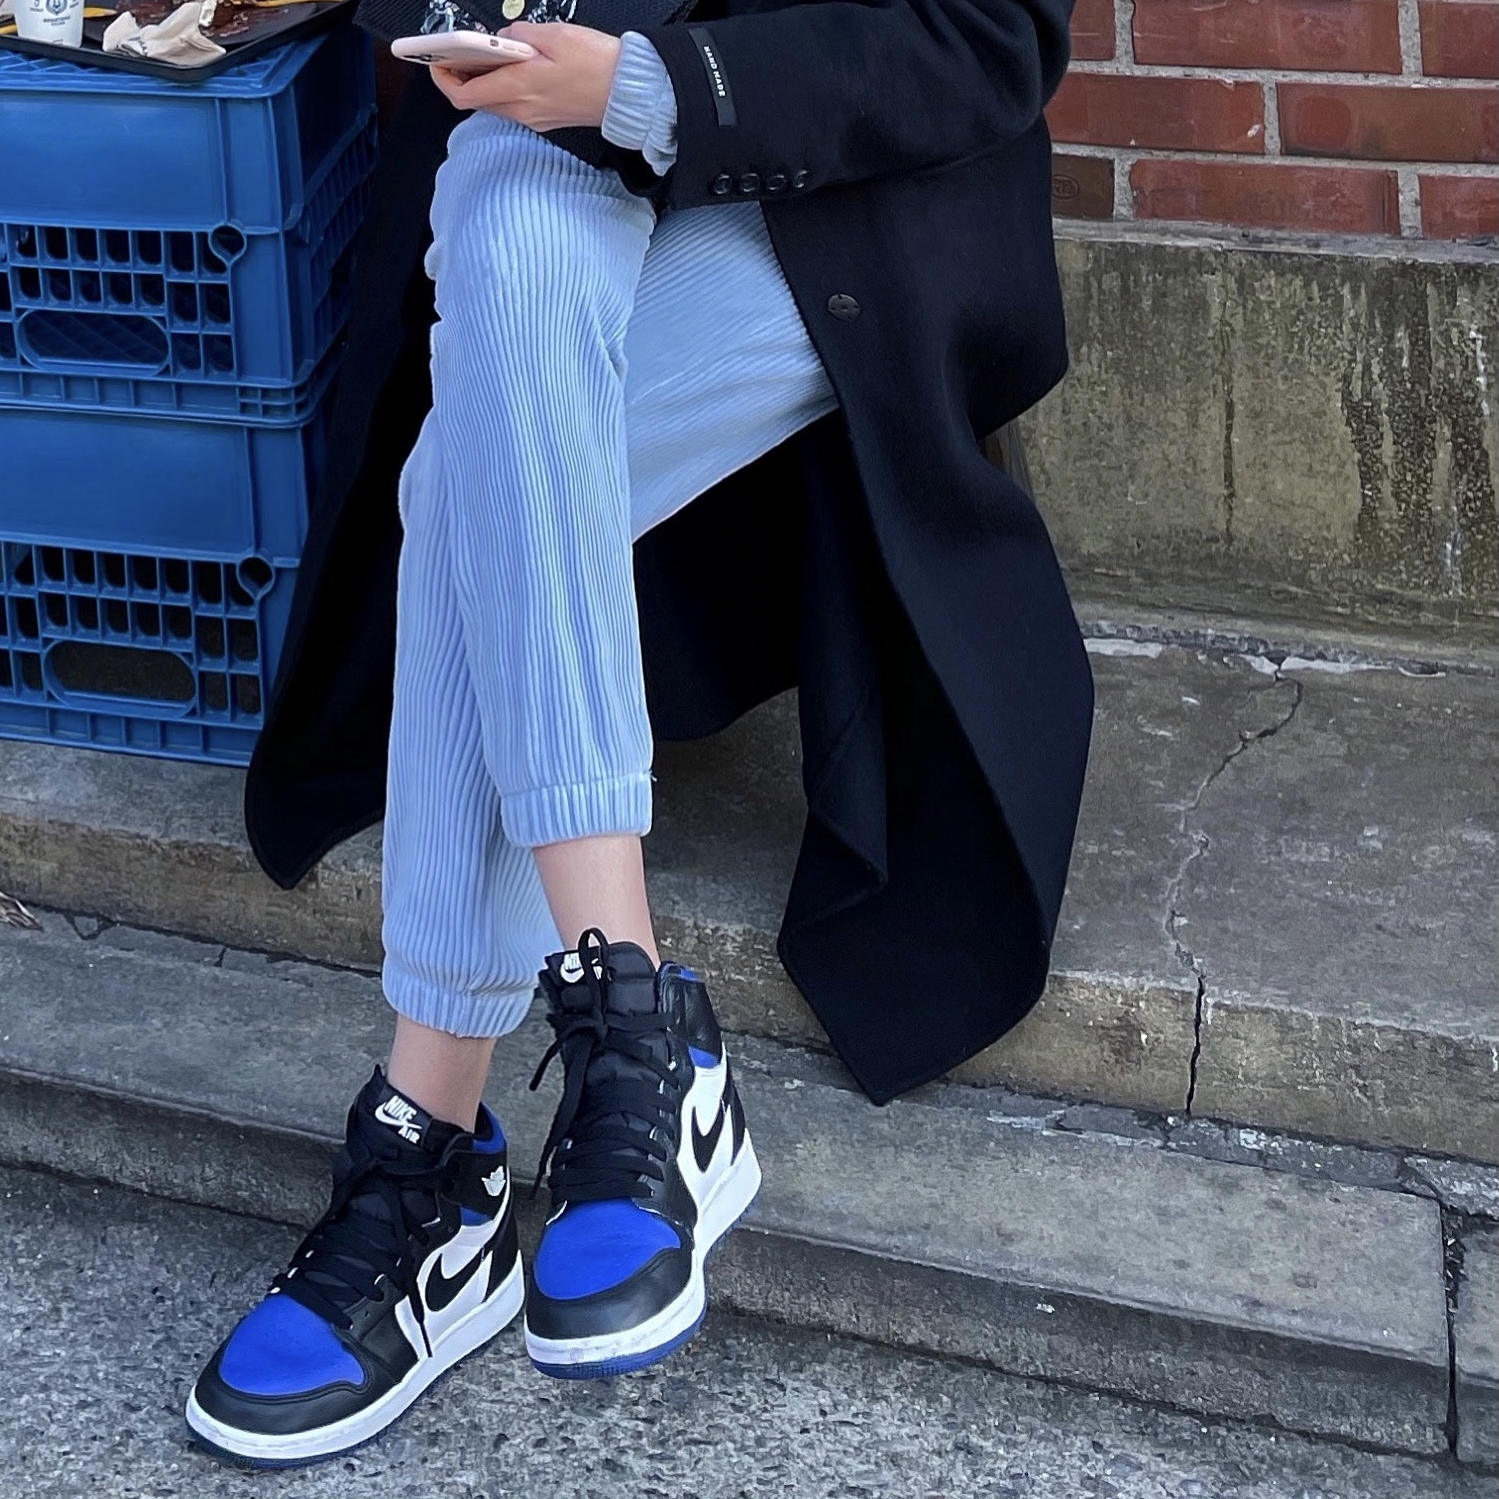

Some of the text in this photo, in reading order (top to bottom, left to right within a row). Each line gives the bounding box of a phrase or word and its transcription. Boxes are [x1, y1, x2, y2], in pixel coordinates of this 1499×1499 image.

[704, 46, 726, 97] HAND MADE
[383, 1095, 418, 1122] NIKE
[397, 1125, 421, 1144] AIR
